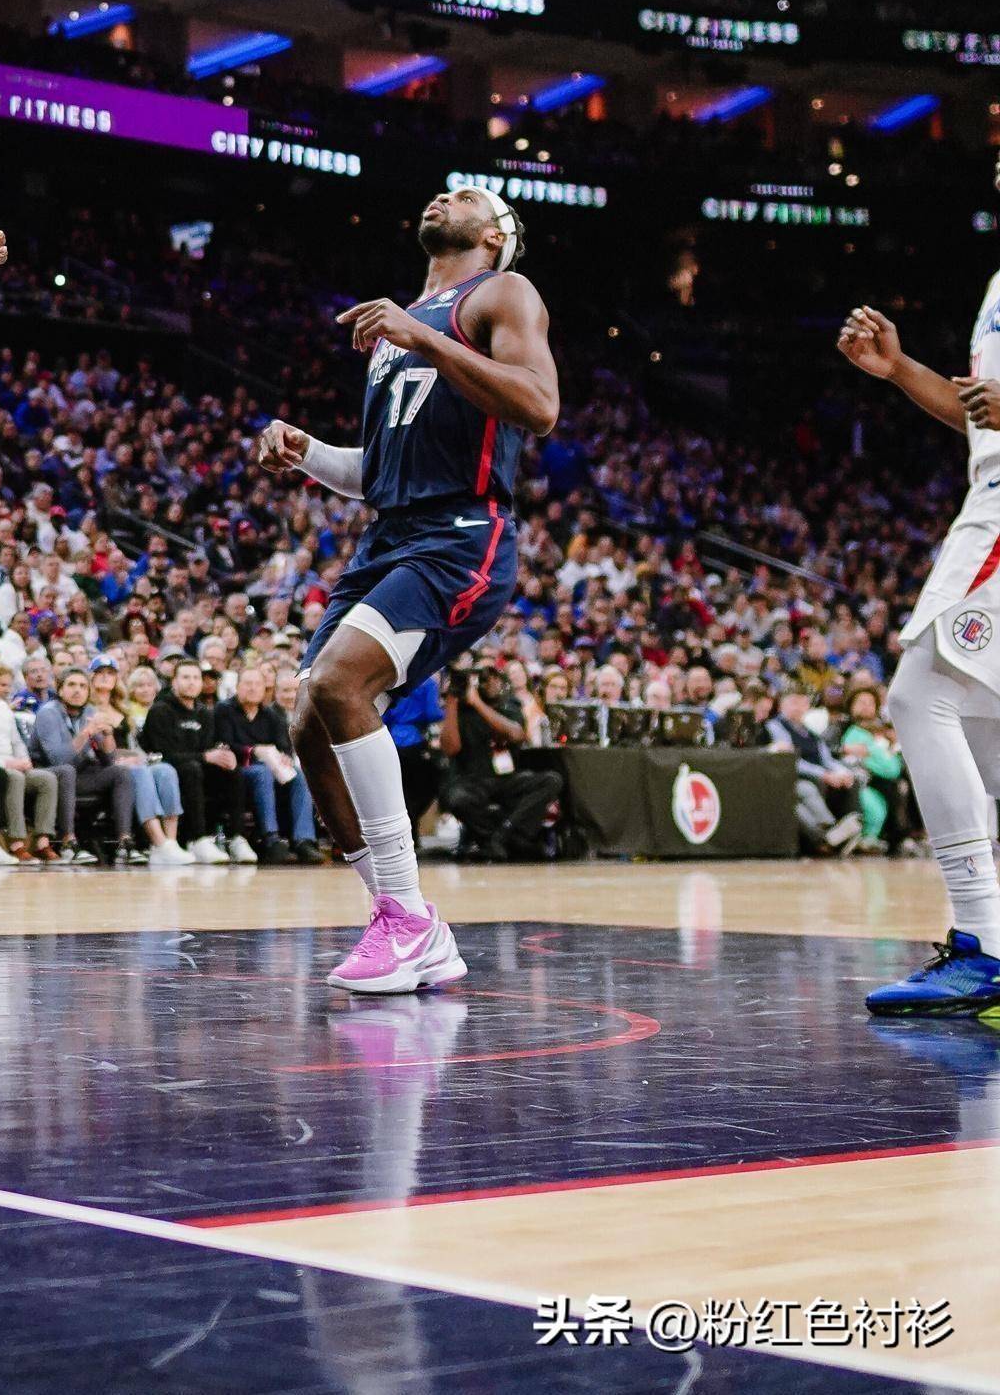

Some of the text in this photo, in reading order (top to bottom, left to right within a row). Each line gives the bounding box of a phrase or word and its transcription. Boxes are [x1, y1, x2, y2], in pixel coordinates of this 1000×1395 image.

[9, 95, 112, 133] FITNESS
[211, 130, 361, 177] CITY FITNESS
[388, 367, 438, 429] 17
